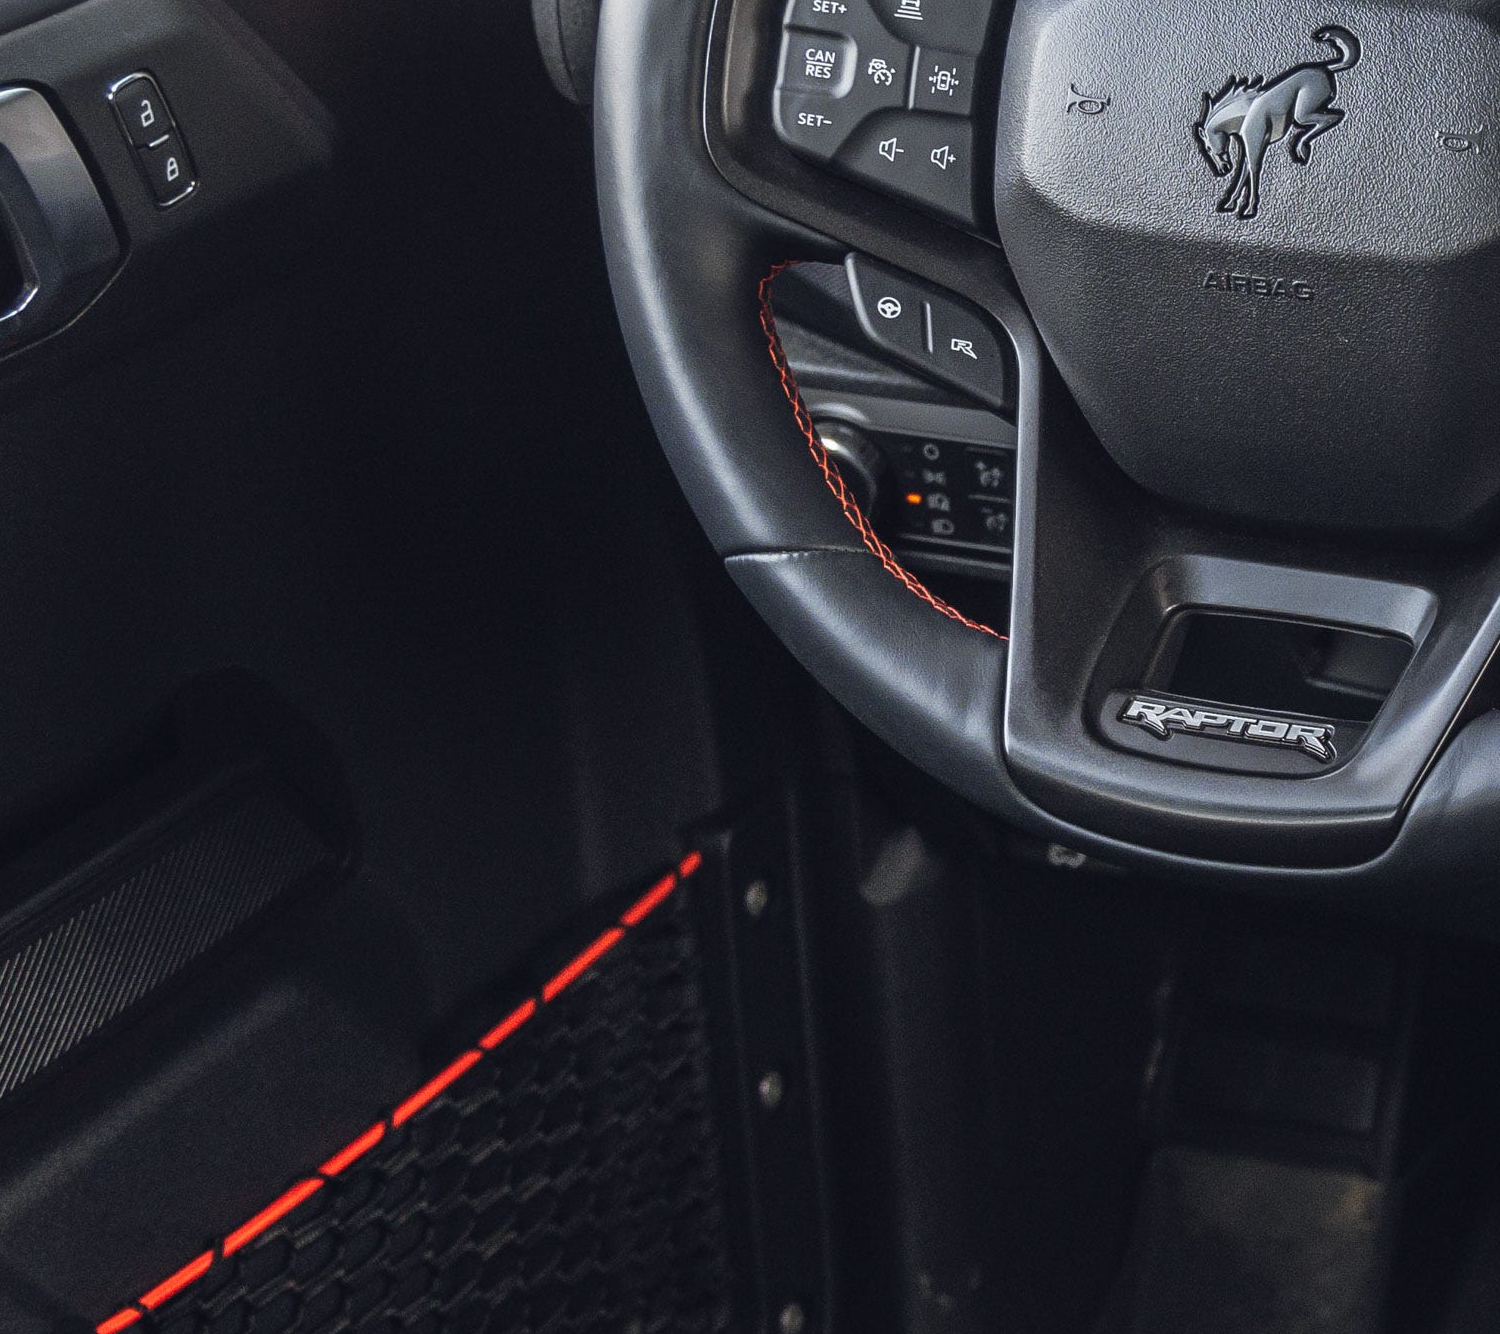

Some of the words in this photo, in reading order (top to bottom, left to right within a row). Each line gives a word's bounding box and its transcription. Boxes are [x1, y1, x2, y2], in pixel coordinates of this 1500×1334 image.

[805, 48, 836, 63] CAN
[804, 64, 832, 79] RES
[1203, 270, 1315, 301] AIRBAG
[1121, 699, 1334, 761] RAPTOR
